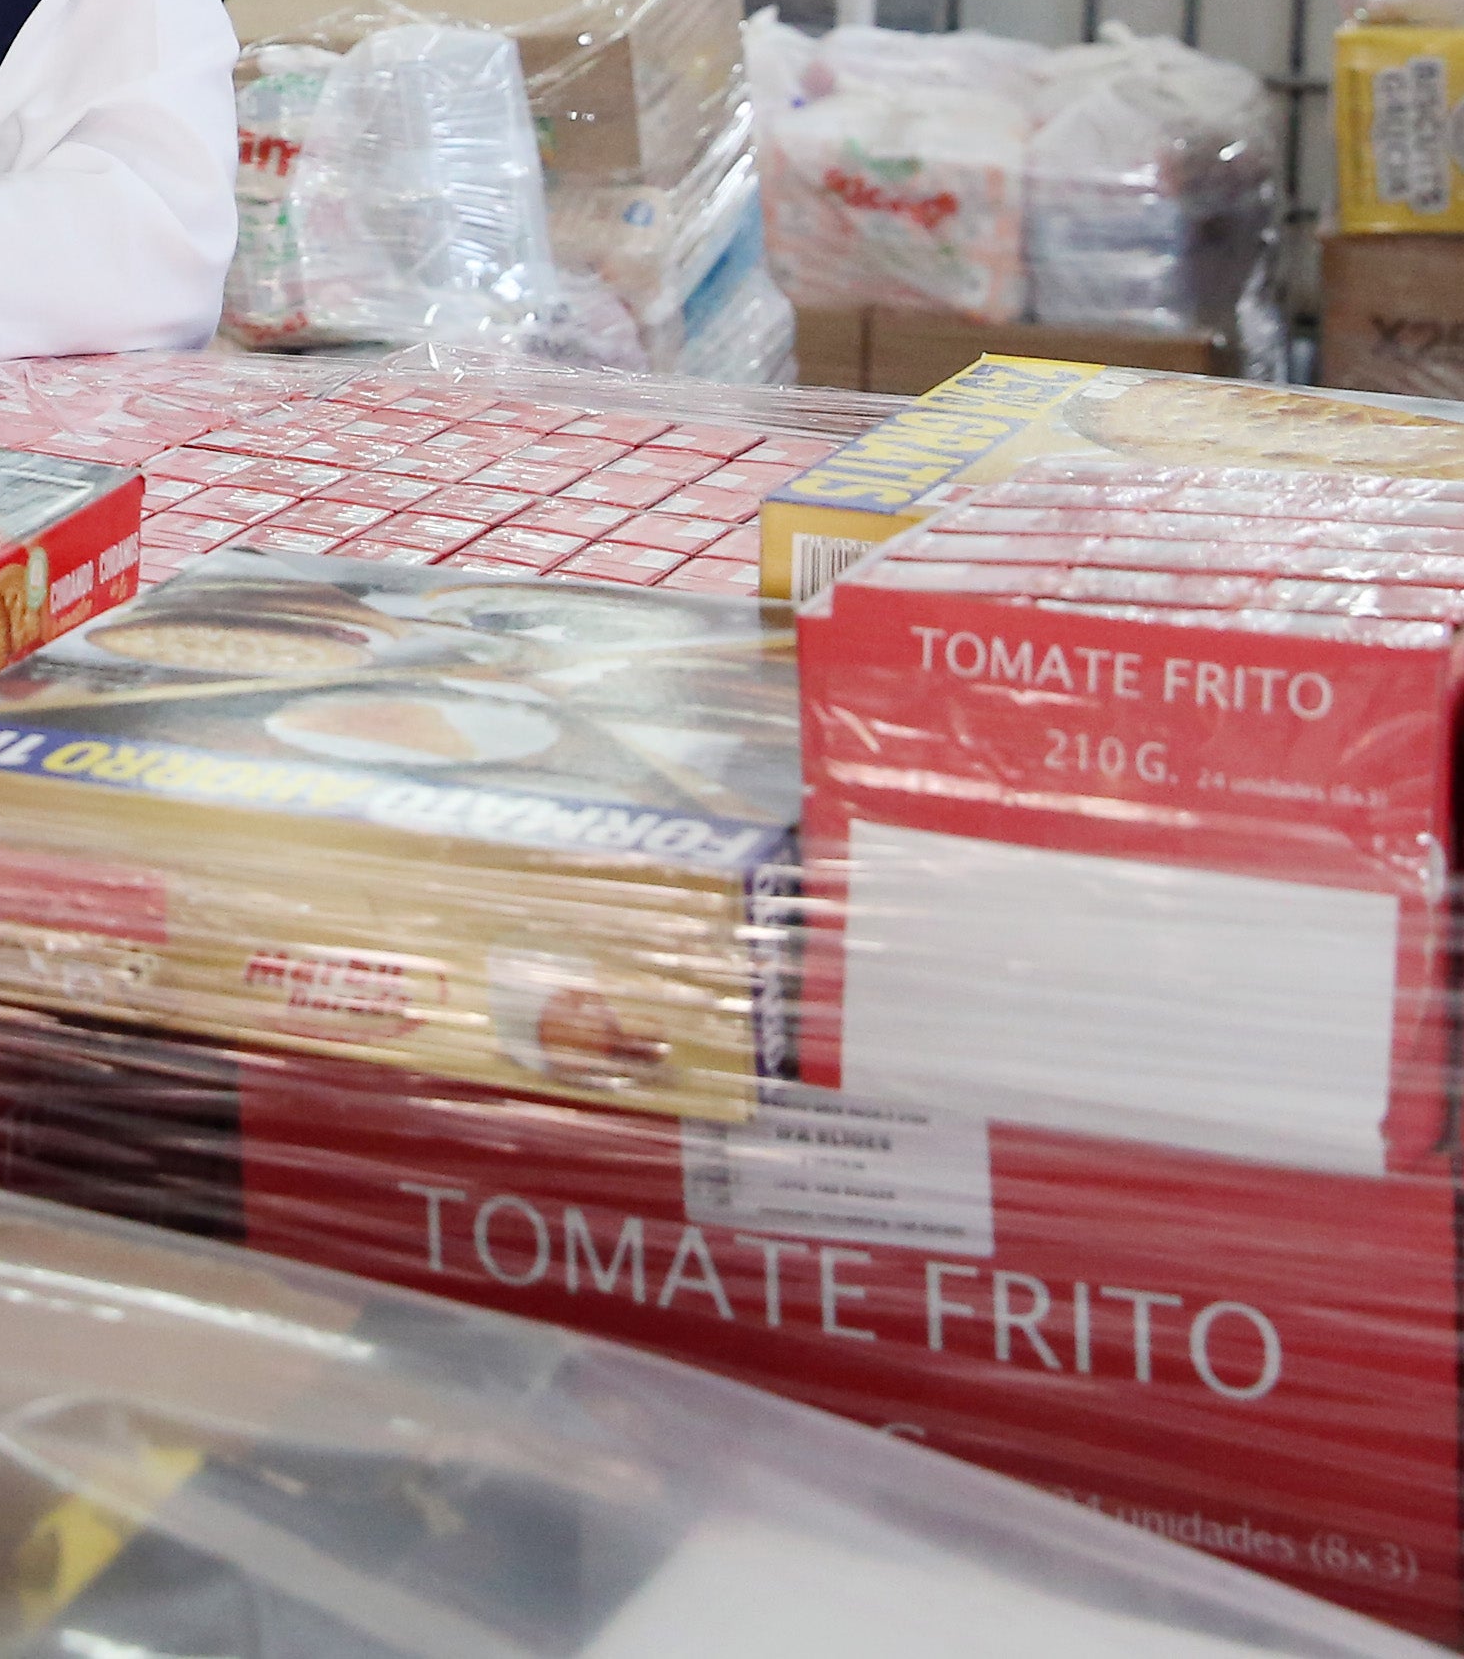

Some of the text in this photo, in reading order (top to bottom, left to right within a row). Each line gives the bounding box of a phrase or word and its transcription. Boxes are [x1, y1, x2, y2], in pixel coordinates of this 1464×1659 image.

[788, 409, 1011, 505] GRATIS
[910, 624, 1334, 721] TOMATE FRITO
[40, 740, 376, 814] AHORRO
[365, 782, 762, 863] FORMATO
[397, 1180, 1284, 1402] TOMATE FRITO
